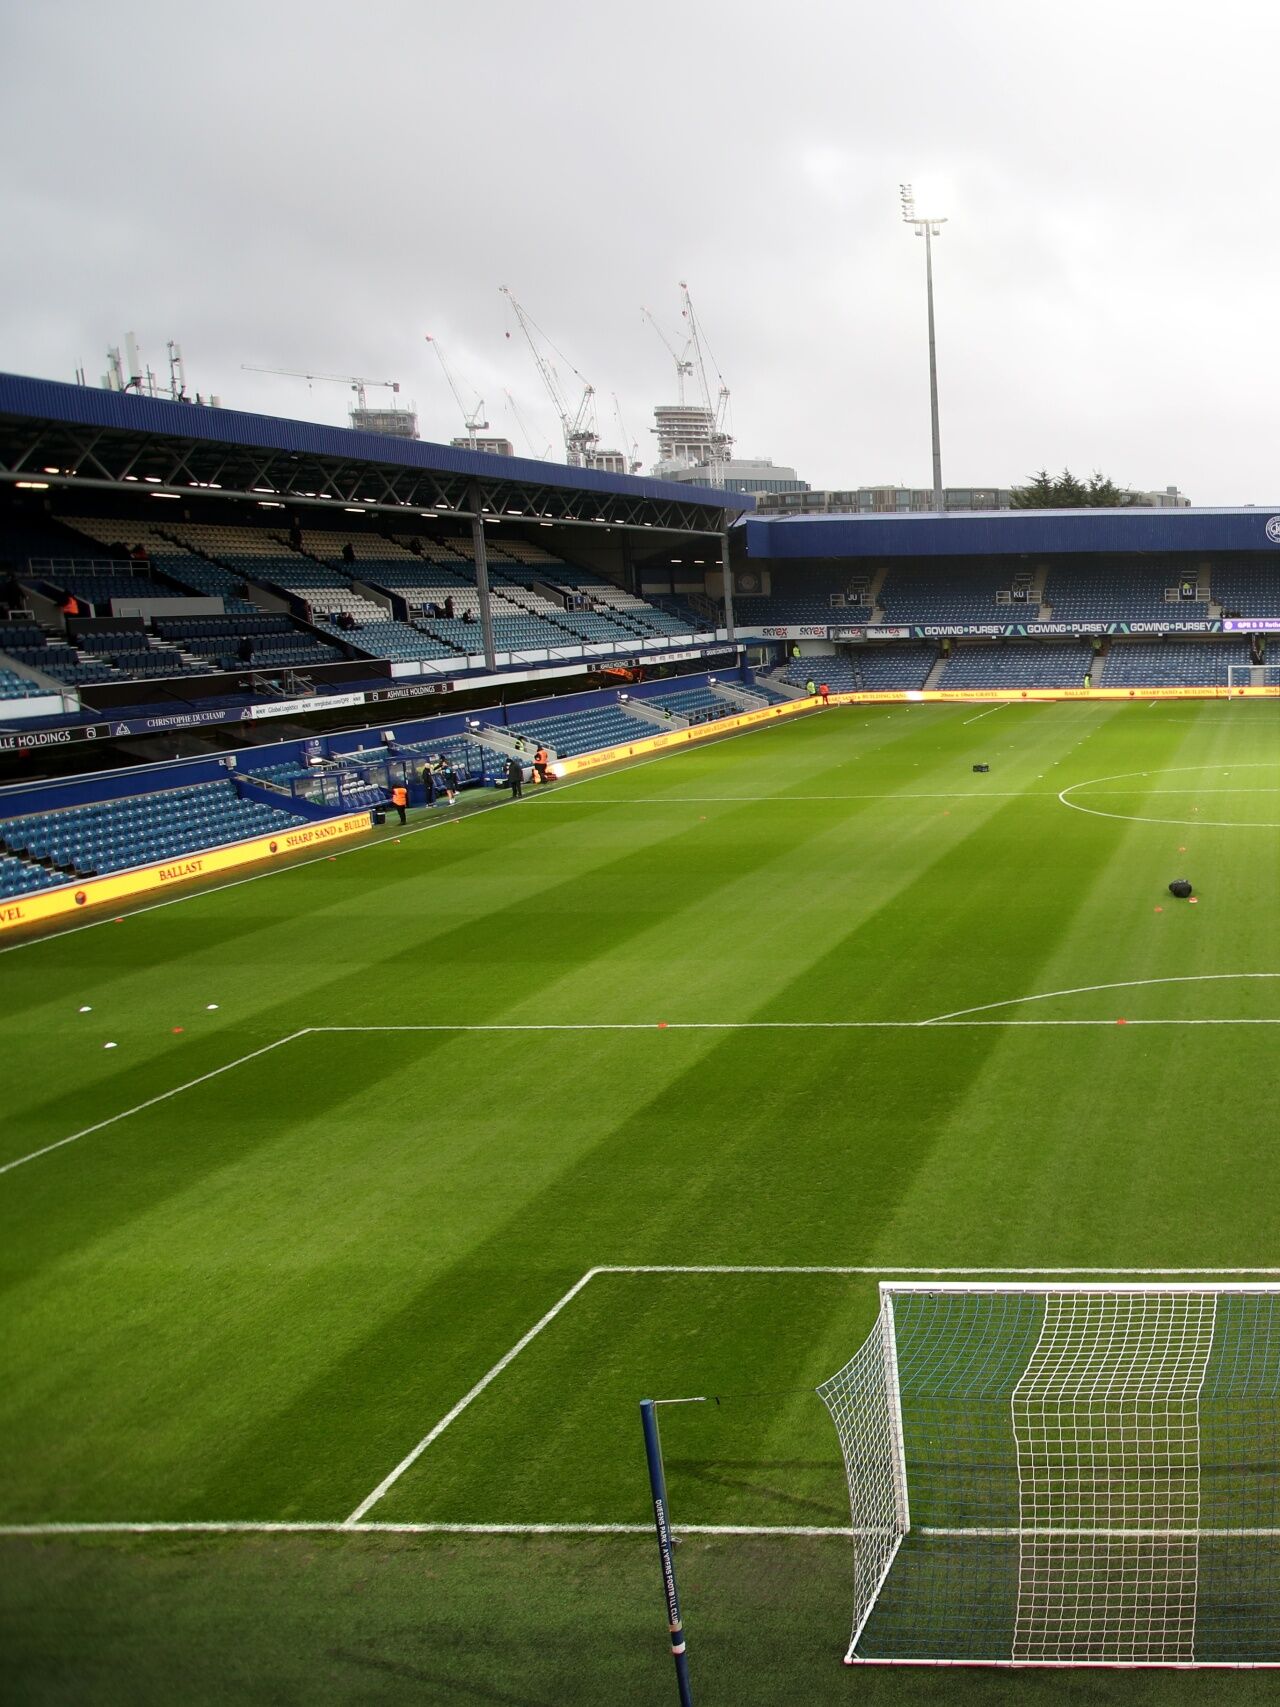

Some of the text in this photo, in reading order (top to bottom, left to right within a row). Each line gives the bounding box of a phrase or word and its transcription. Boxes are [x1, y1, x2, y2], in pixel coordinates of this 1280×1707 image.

[924, 625, 1006, 636] GOWING PURSEY
[1027, 622, 1109, 633] GOWING PURSEY
[1130, 621, 1212, 632] GOWING PURSEY
[386, 685, 435, 699] ASHVILLE HOLDINGS
[267, 705, 282, 714] Global
[146, 714, 193, 728] CHRISTOPHE
[193, 710, 226, 722] DUCHAMP
[18, 730, 71, 747] HOLDINGS
[286, 831, 314, 847] SHARP
[315, 825, 337, 839] SAND
[159, 860, 203, 881] BALLAST
[655, 1500, 665, 1526] QUEENS
